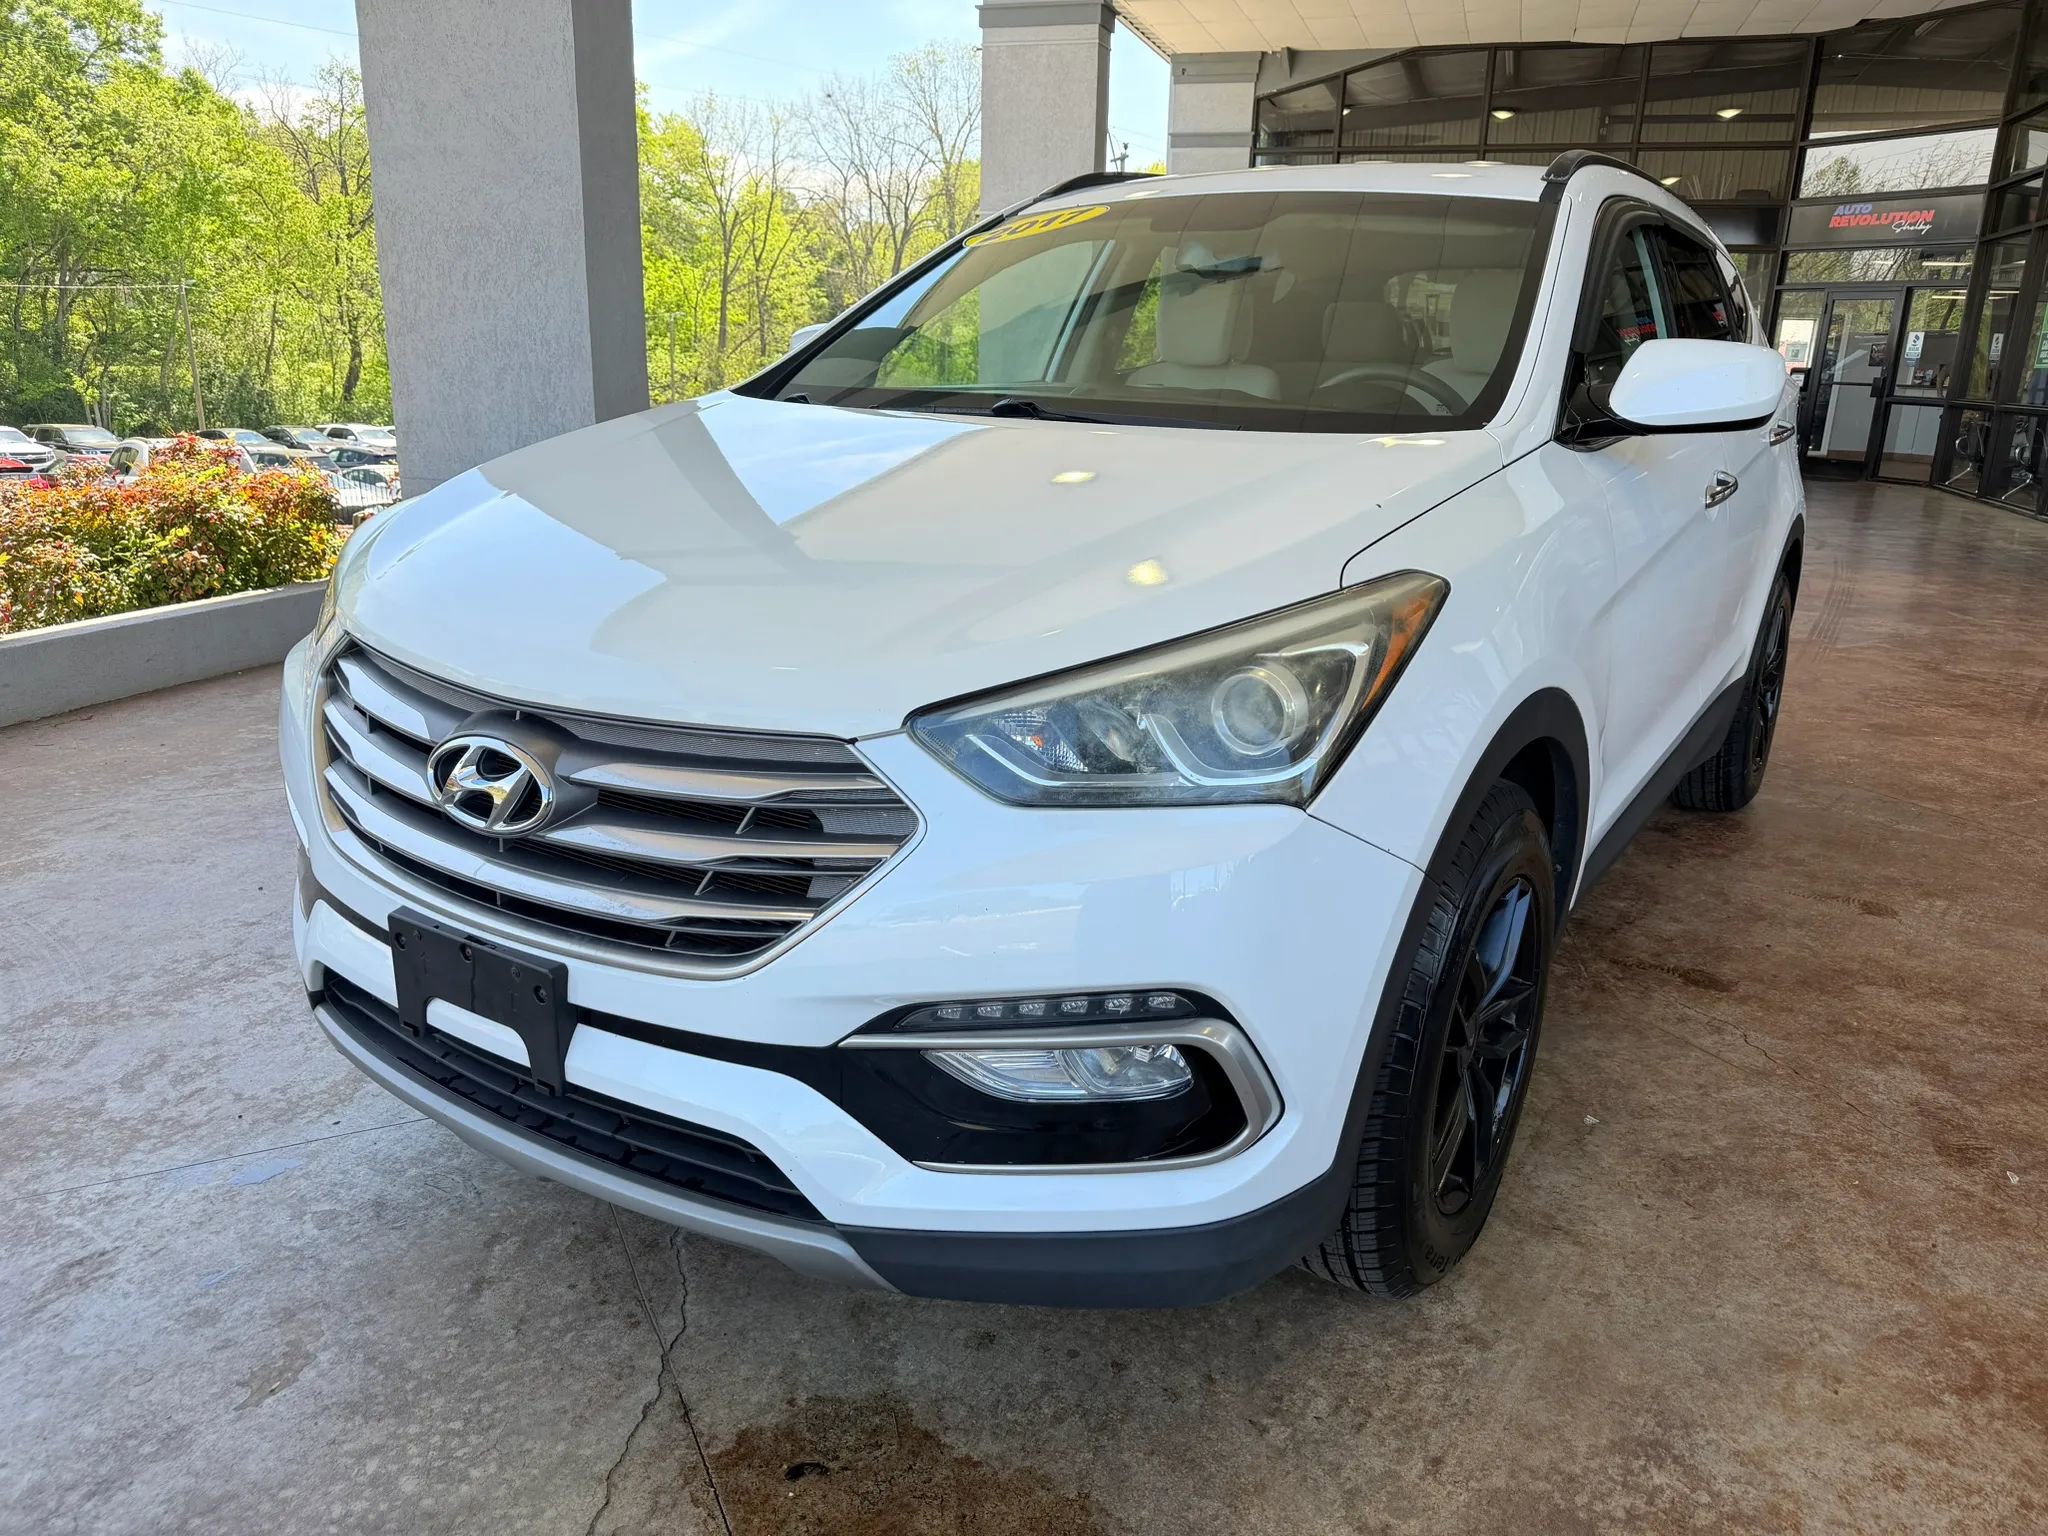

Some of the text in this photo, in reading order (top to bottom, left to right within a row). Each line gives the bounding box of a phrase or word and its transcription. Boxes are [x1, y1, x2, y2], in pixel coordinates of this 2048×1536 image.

[1834, 203, 1873, 216] AUTO
[975, 206, 1097, 245] 2017
[1829, 209, 1936, 228] REVOLUTION
[1891, 219, 1933, 235] Shelby
